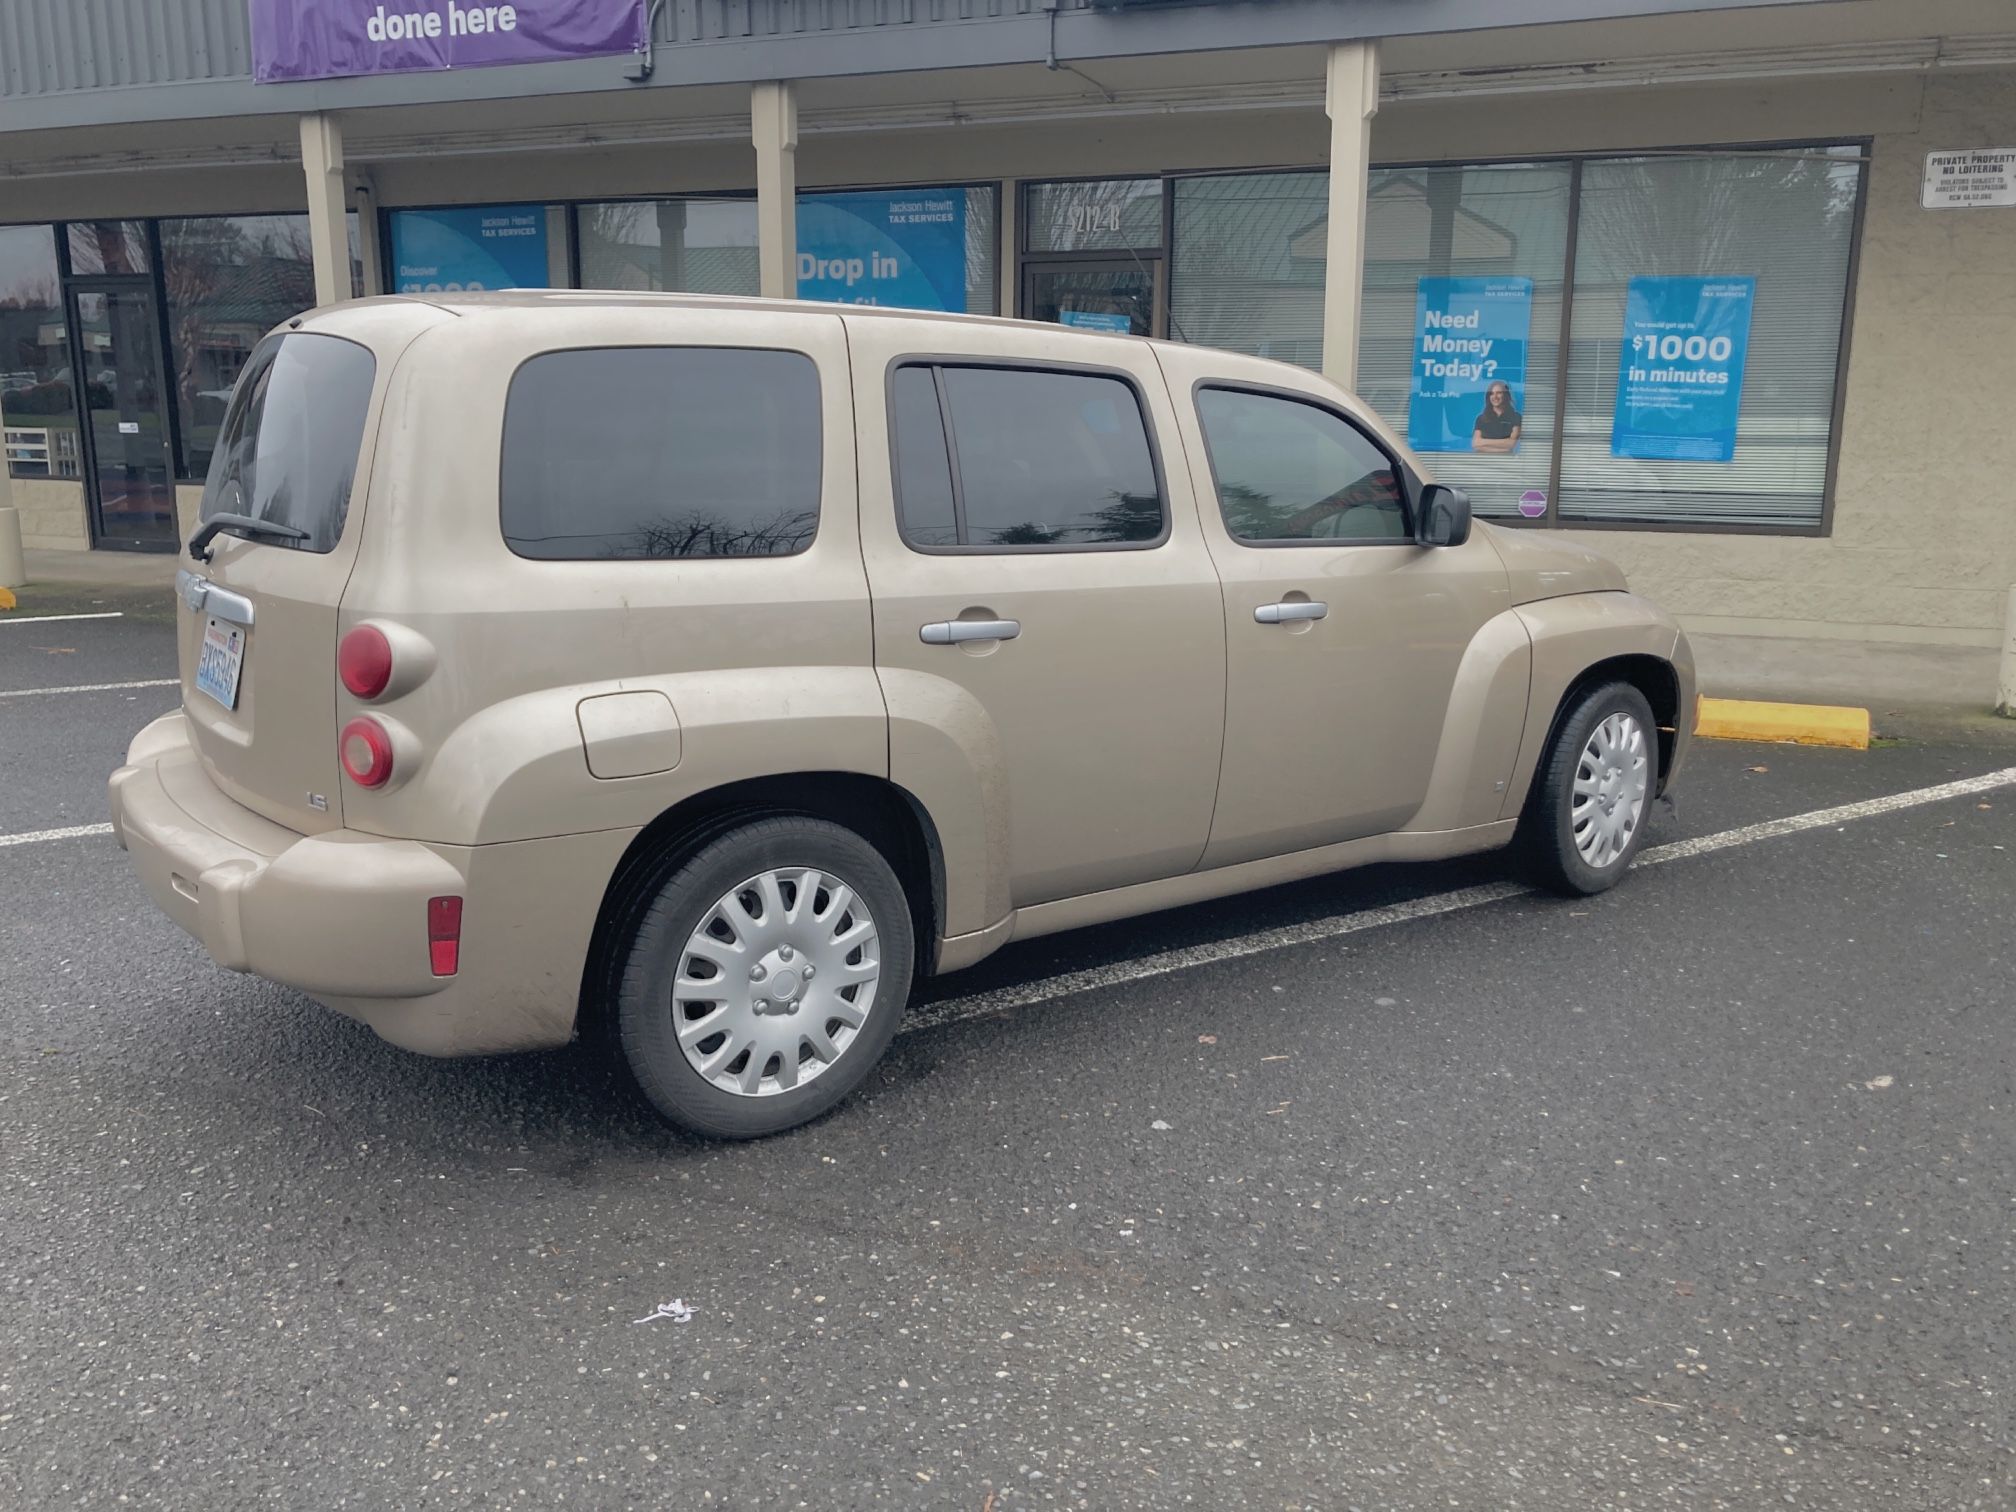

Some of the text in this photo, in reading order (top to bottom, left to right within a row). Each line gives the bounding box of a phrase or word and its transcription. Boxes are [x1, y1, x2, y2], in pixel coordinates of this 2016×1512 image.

[367, 0, 517, 42] done here
[1931, 154, 2016, 166] PRIVATE PROPERTY
[1942, 164, 2004, 175] NO LOITERING
[889, 200, 953, 213] Jackson Hewitt
[888, 213, 953, 224] TAX SERVICES
[481, 227, 537, 237] TAX SERVICES
[400, 265, 438, 277] Discover
[796, 250, 898, 286] Drop in
[1424, 309, 1479, 329] Need
[1422, 334, 1493, 357] Money
[1632, 334, 1732, 362] $1000
[1420, 358, 1498, 381] Today?
[1628, 365, 1729, 384] in minutes
